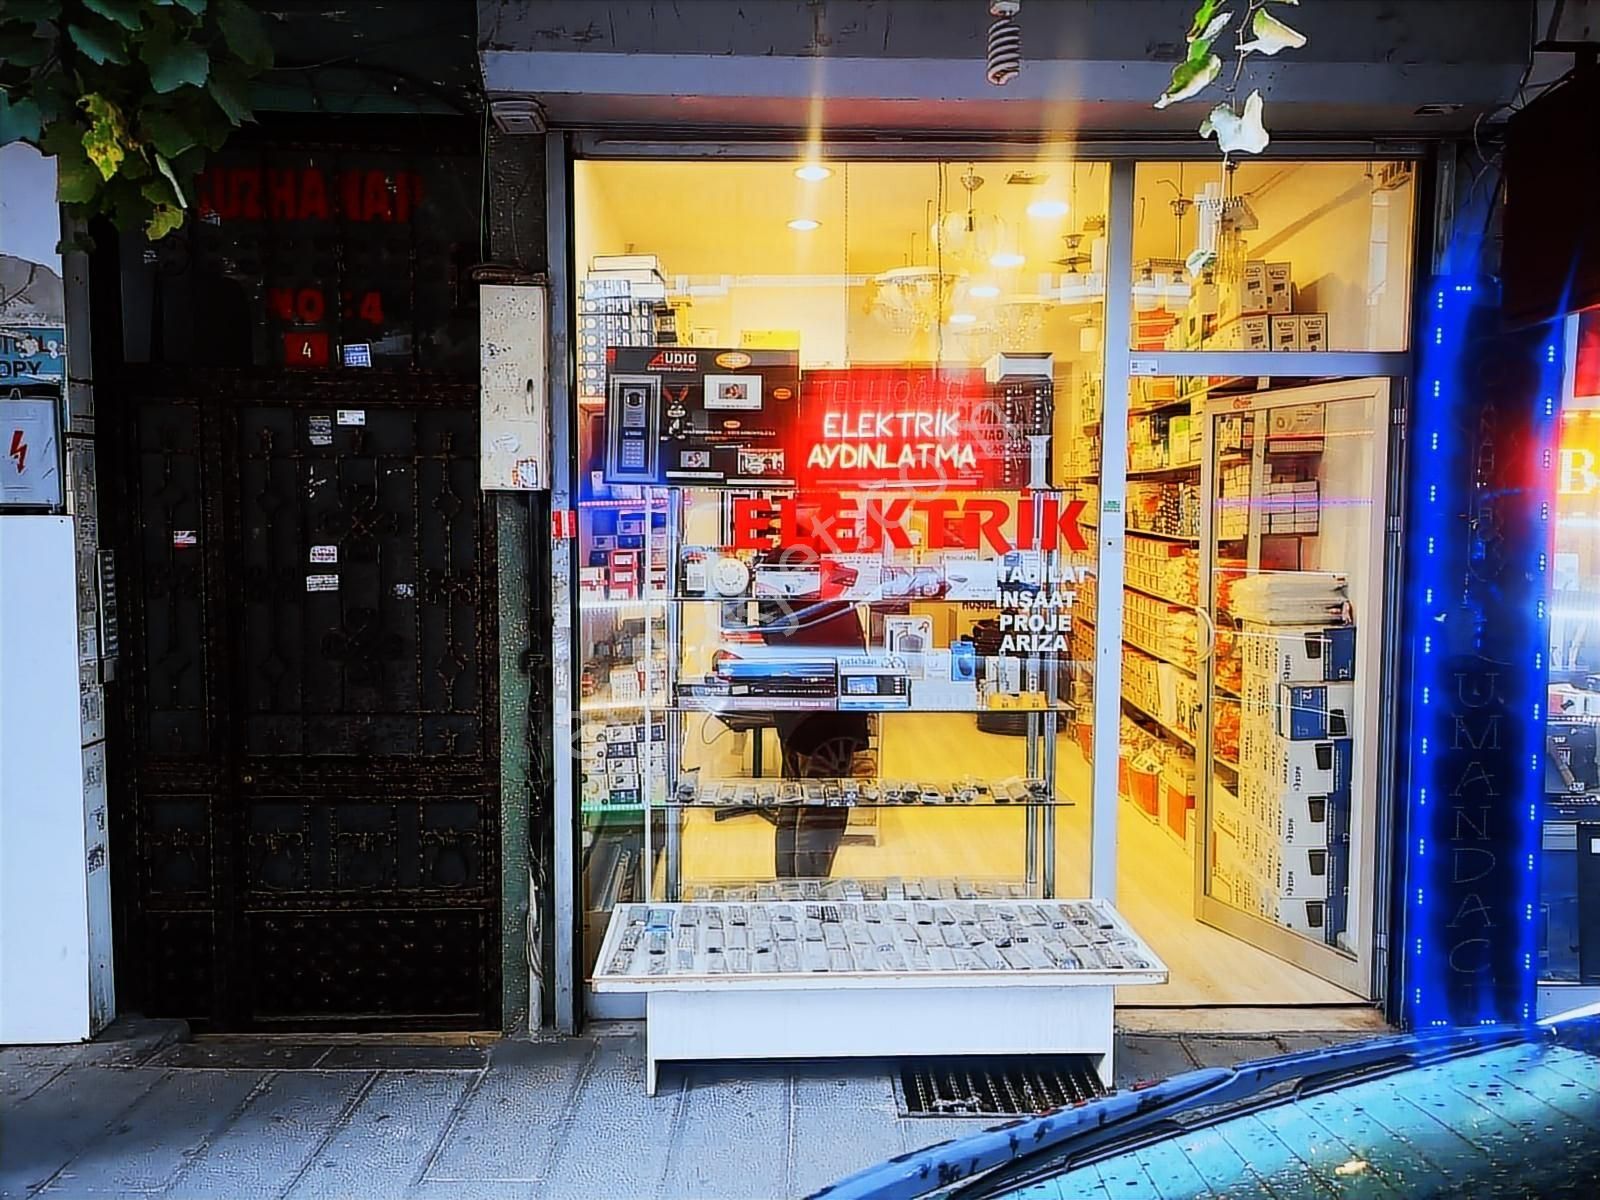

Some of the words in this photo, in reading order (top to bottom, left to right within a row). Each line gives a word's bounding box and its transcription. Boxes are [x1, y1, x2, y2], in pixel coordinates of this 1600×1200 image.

[302, 342, 312, 359] 4
[823, 407, 961, 439] ELEKTRİK
[806, 442, 978, 470] AYDINLATMA
[733, 488, 1089, 554] ELEKTRİK
[1000, 614, 1072, 632] PROJE
[1000, 634, 1068, 652] ARIZA
